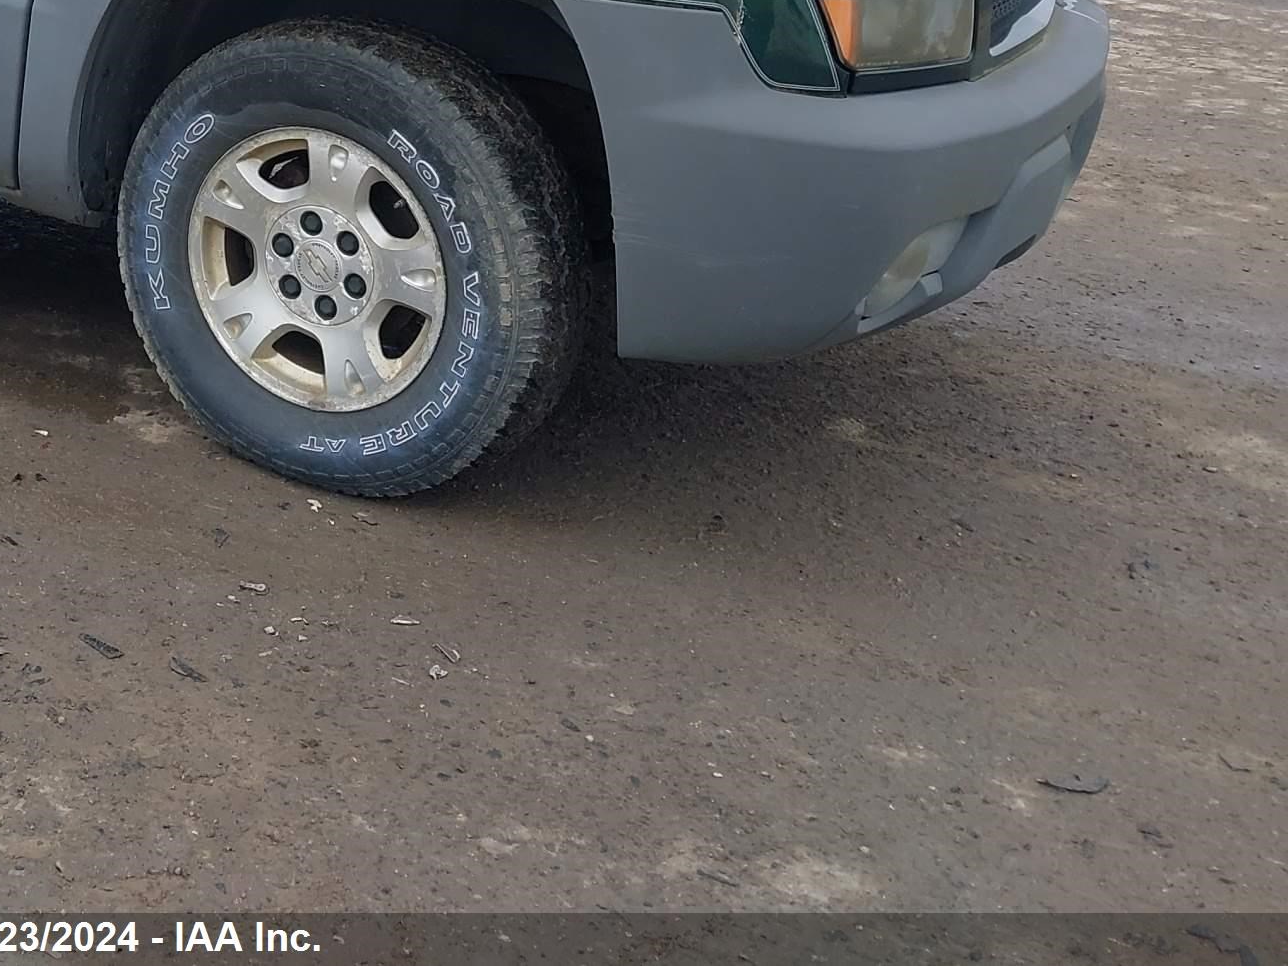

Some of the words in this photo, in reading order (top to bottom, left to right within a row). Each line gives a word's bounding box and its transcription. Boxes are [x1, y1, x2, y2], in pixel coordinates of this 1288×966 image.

[145, 113, 215, 310] KUMHO
[387, 130, 472, 253] ROAD
[360, 271, 481, 456] VENTURE
[300, 436, 346, 453] AT
